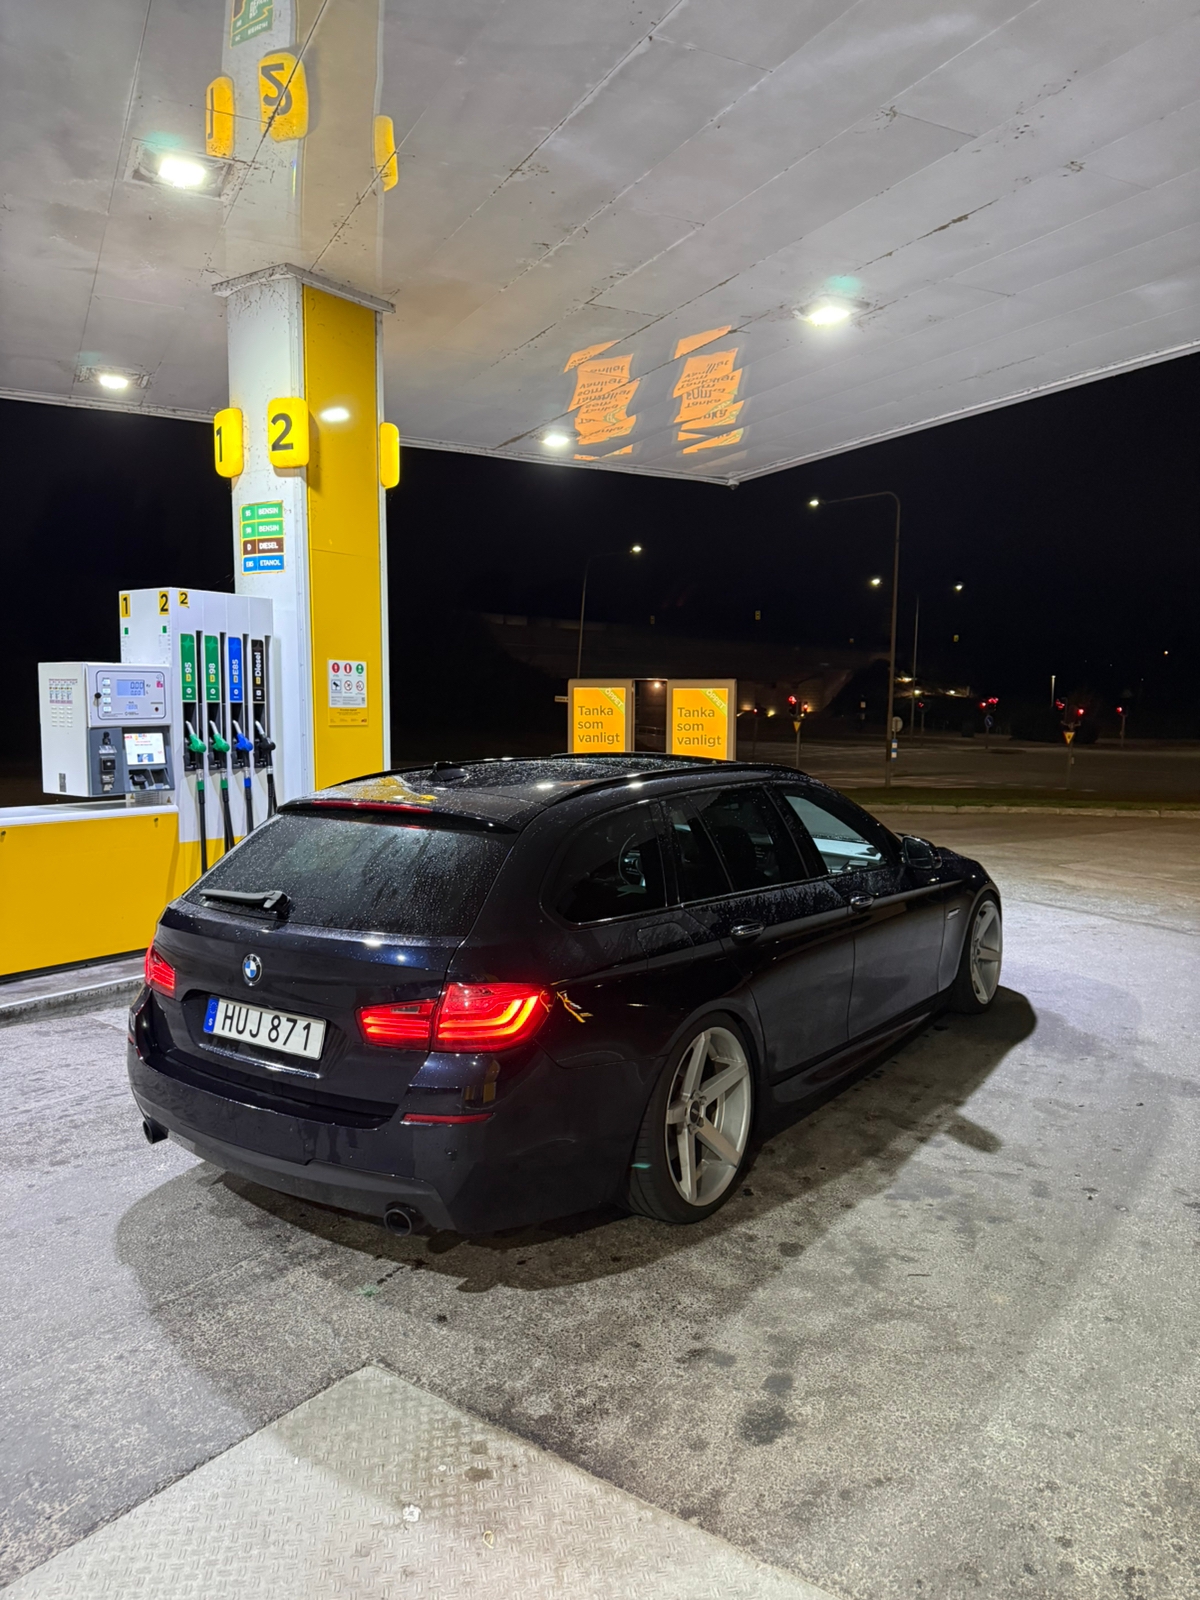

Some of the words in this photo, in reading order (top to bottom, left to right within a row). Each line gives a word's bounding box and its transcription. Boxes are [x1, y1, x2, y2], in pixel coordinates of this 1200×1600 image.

[270, 413, 294, 452] 2
[215, 426, 223, 463] 1
[258, 507, 279, 515] BENSIN
[258, 524, 280, 532] BENSIN
[258, 541, 279, 550] DIESEL
[259, 559, 281, 567] ETANOL
[160, 593, 169, 612] 2
[180, 592, 188, 604] 2
[123, 596, 128, 615] 1
[184, 662, 192, 674] 95
[208, 662, 216, 674] 98
[231, 659, 239, 675] E85
[577, 705, 614, 717] Tanka
[677, 706, 715, 718] Tanka
[577, 720, 604, 730] som
[676, 722, 705, 732] som
[577, 732, 620, 745] vanligt
[676, 735, 722, 748] vanligt
[208, 1017, 213, 1026] S
[221, 1004, 262, 1037] HUJ
[268, 1015, 311, 1050] 871
